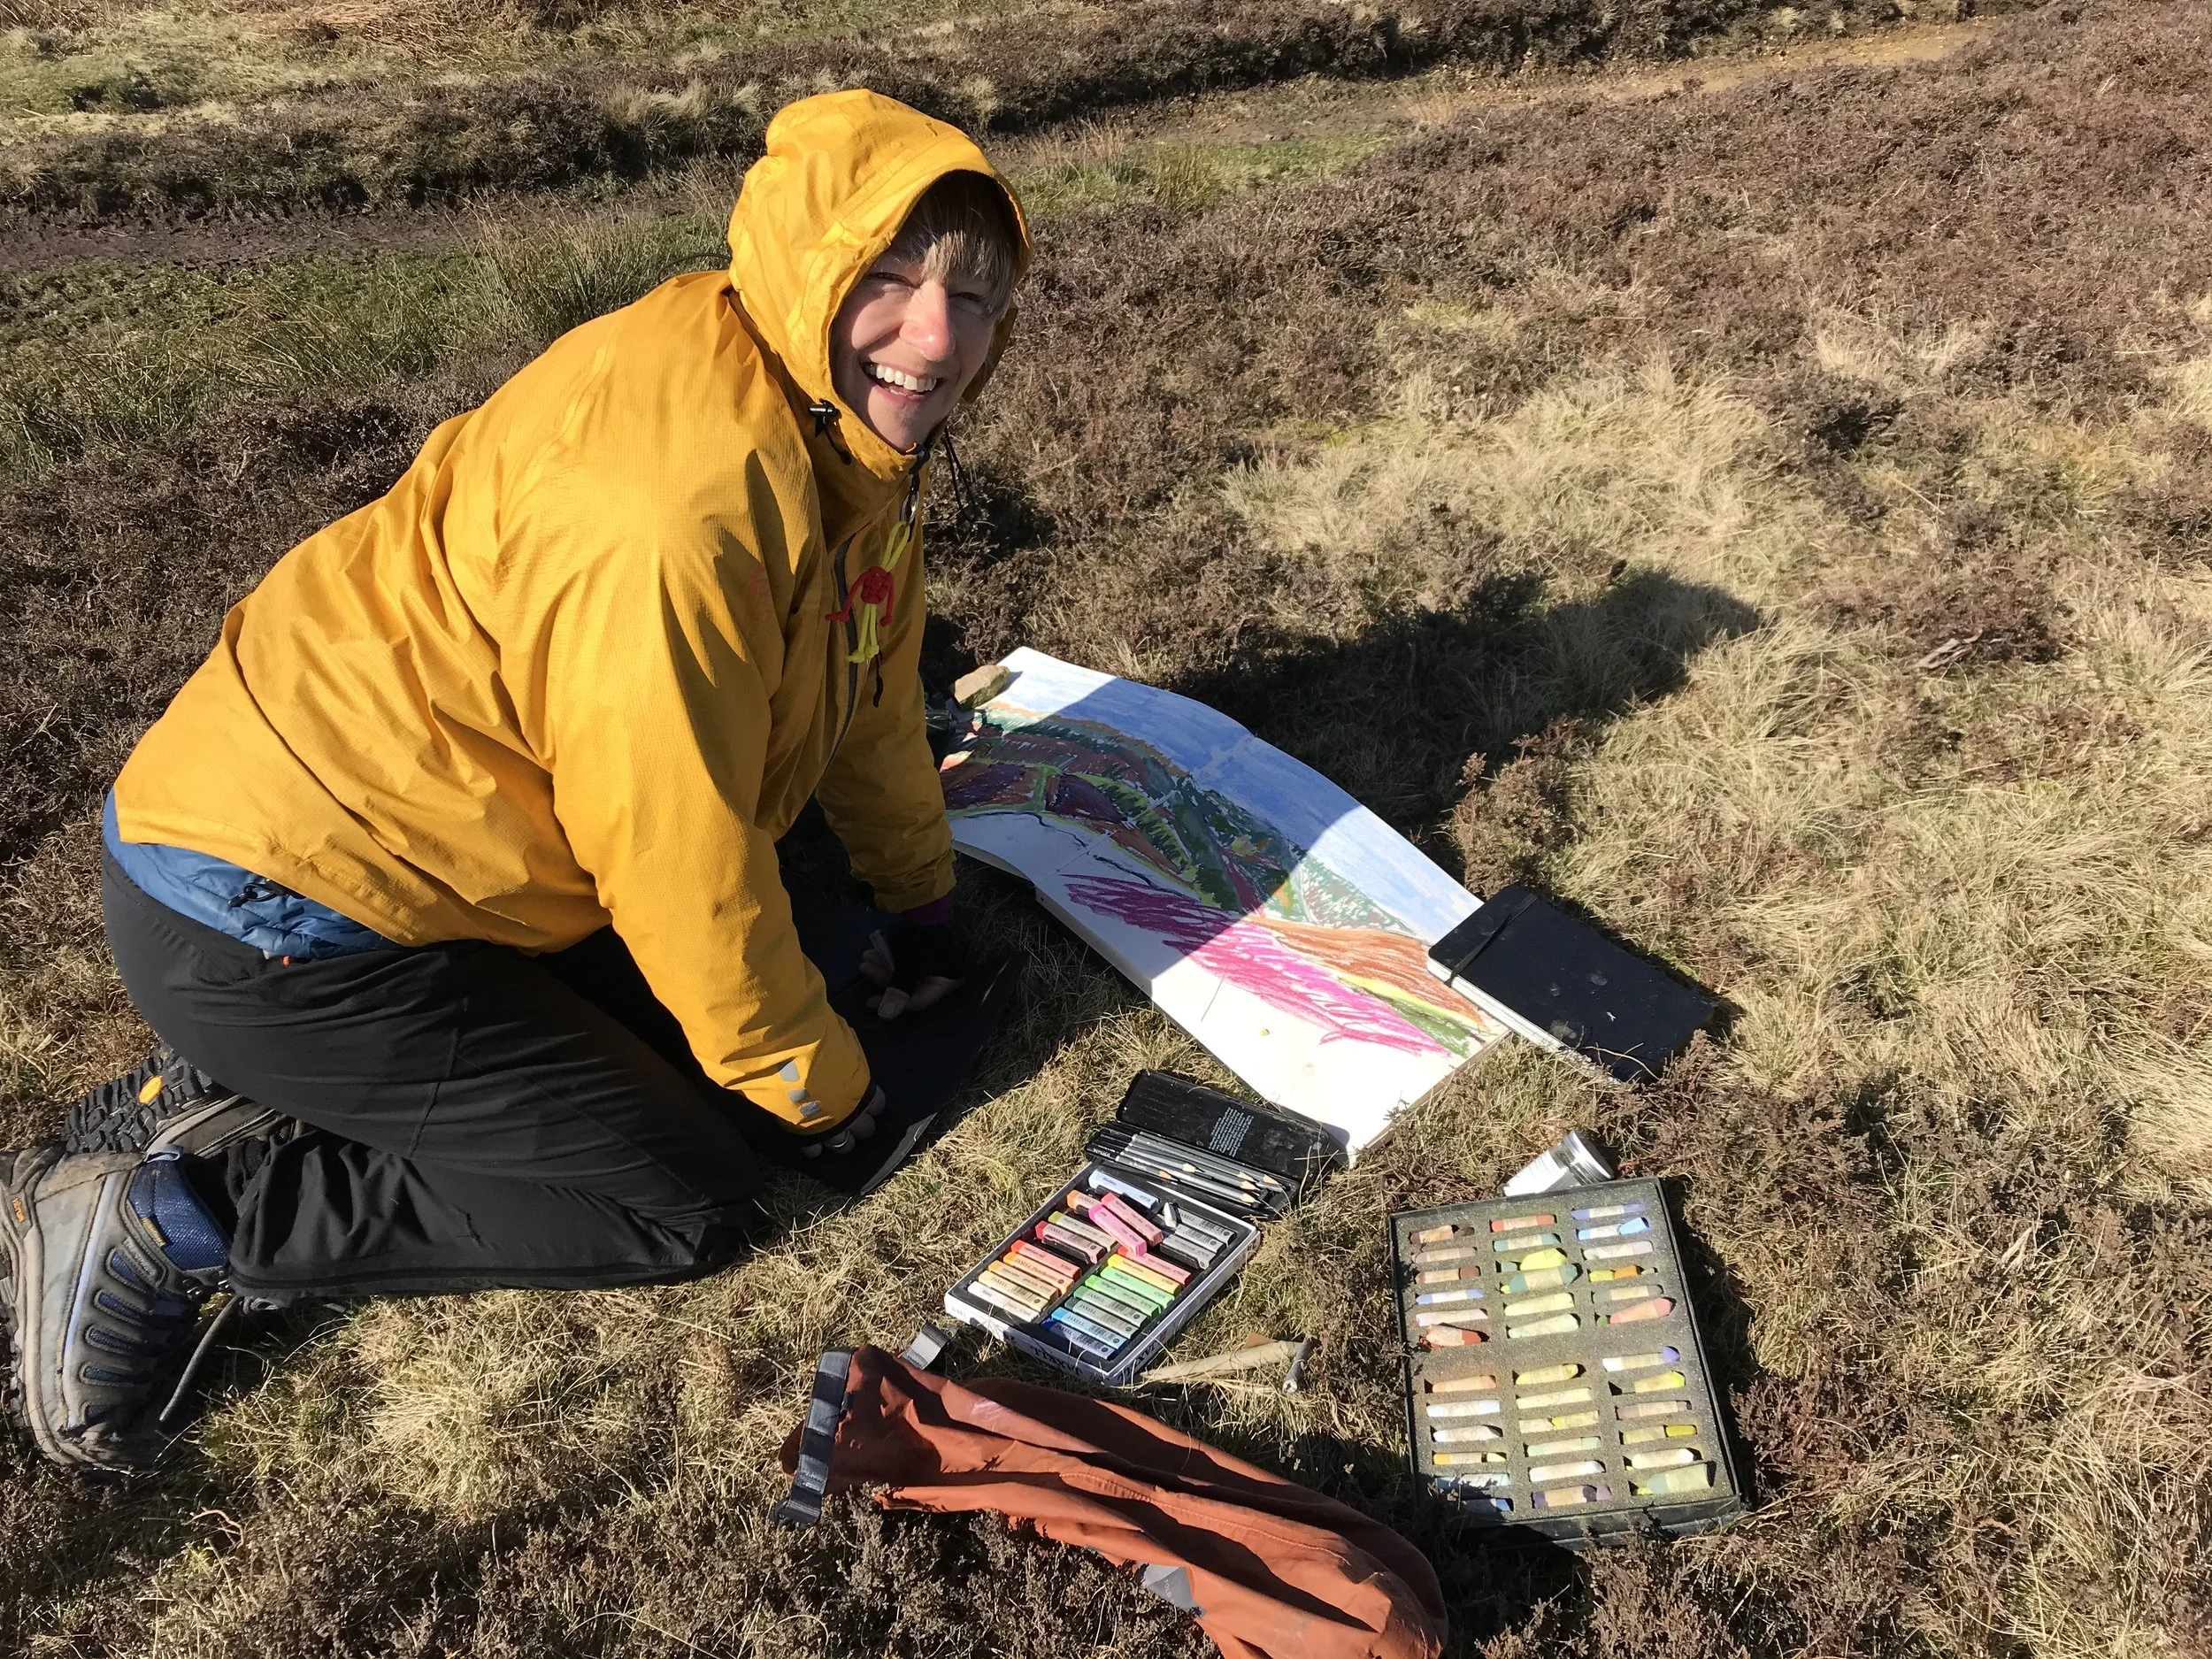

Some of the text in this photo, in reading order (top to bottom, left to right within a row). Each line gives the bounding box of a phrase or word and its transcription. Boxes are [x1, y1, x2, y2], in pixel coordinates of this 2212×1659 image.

[991, 1276, 1009, 1286] JAXELL
[1087, 1291, 1105, 1303] JAXELL
[1079, 1303, 1097, 1315] JAXELL
[1066, 1315, 1085, 1326] JAXELL
[1055, 1323, 1073, 1335] JAXELL
